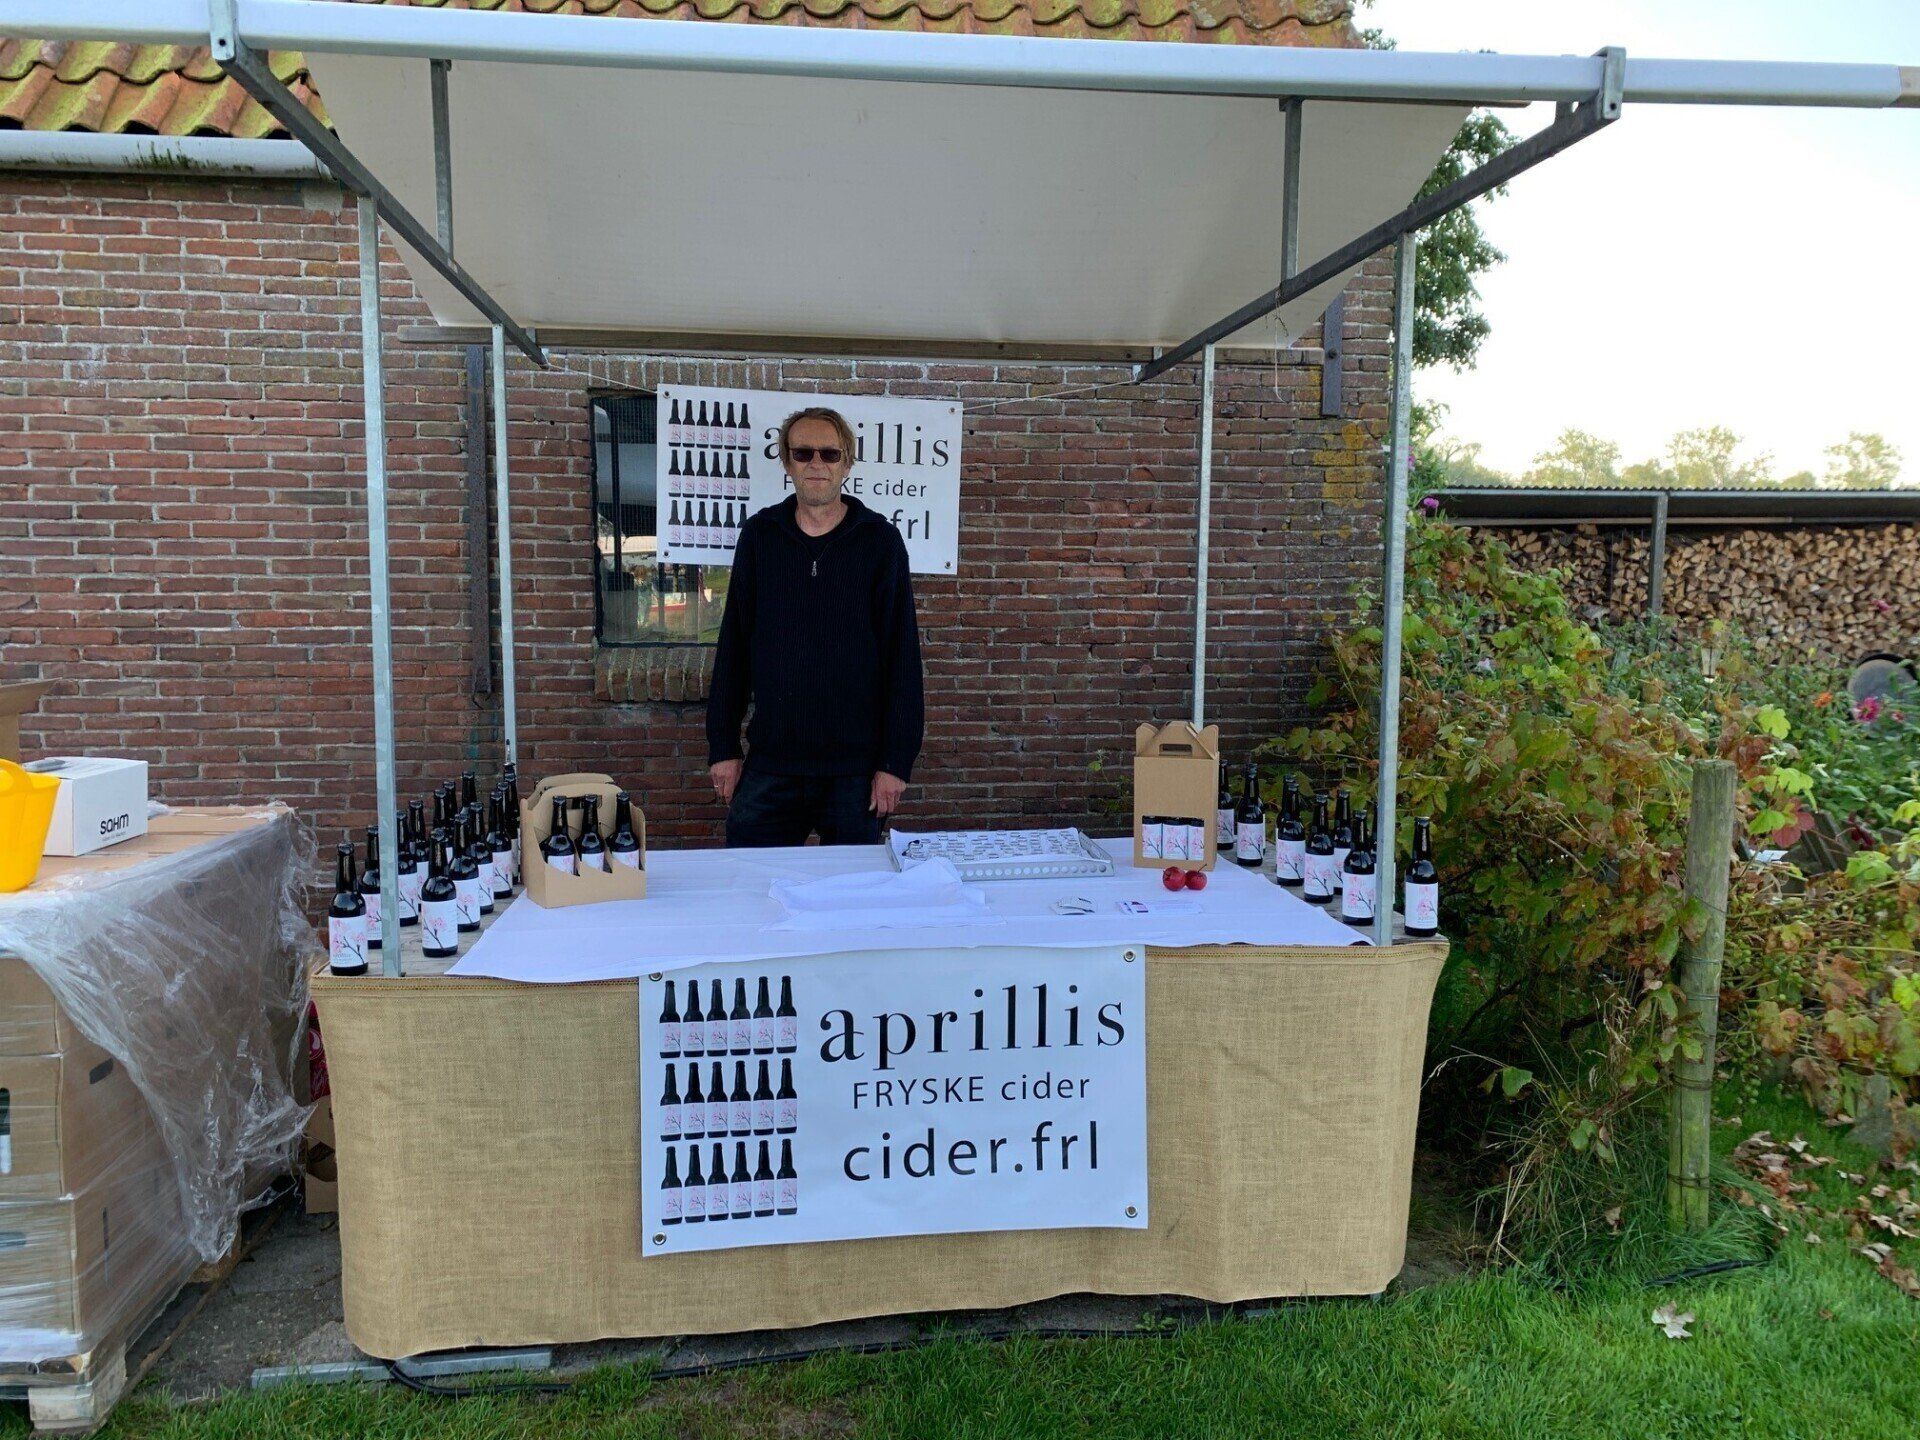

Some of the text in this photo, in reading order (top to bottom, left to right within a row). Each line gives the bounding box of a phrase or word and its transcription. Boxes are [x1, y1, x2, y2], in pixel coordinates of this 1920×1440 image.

[763, 422, 950, 468] aillis
[783, 473, 927, 498] FKE cider
[819, 983, 1126, 1071] aprillis
[853, 1071, 1090, 1110] FRYSKE cider
[843, 1120, 1098, 1182] cider.frl
